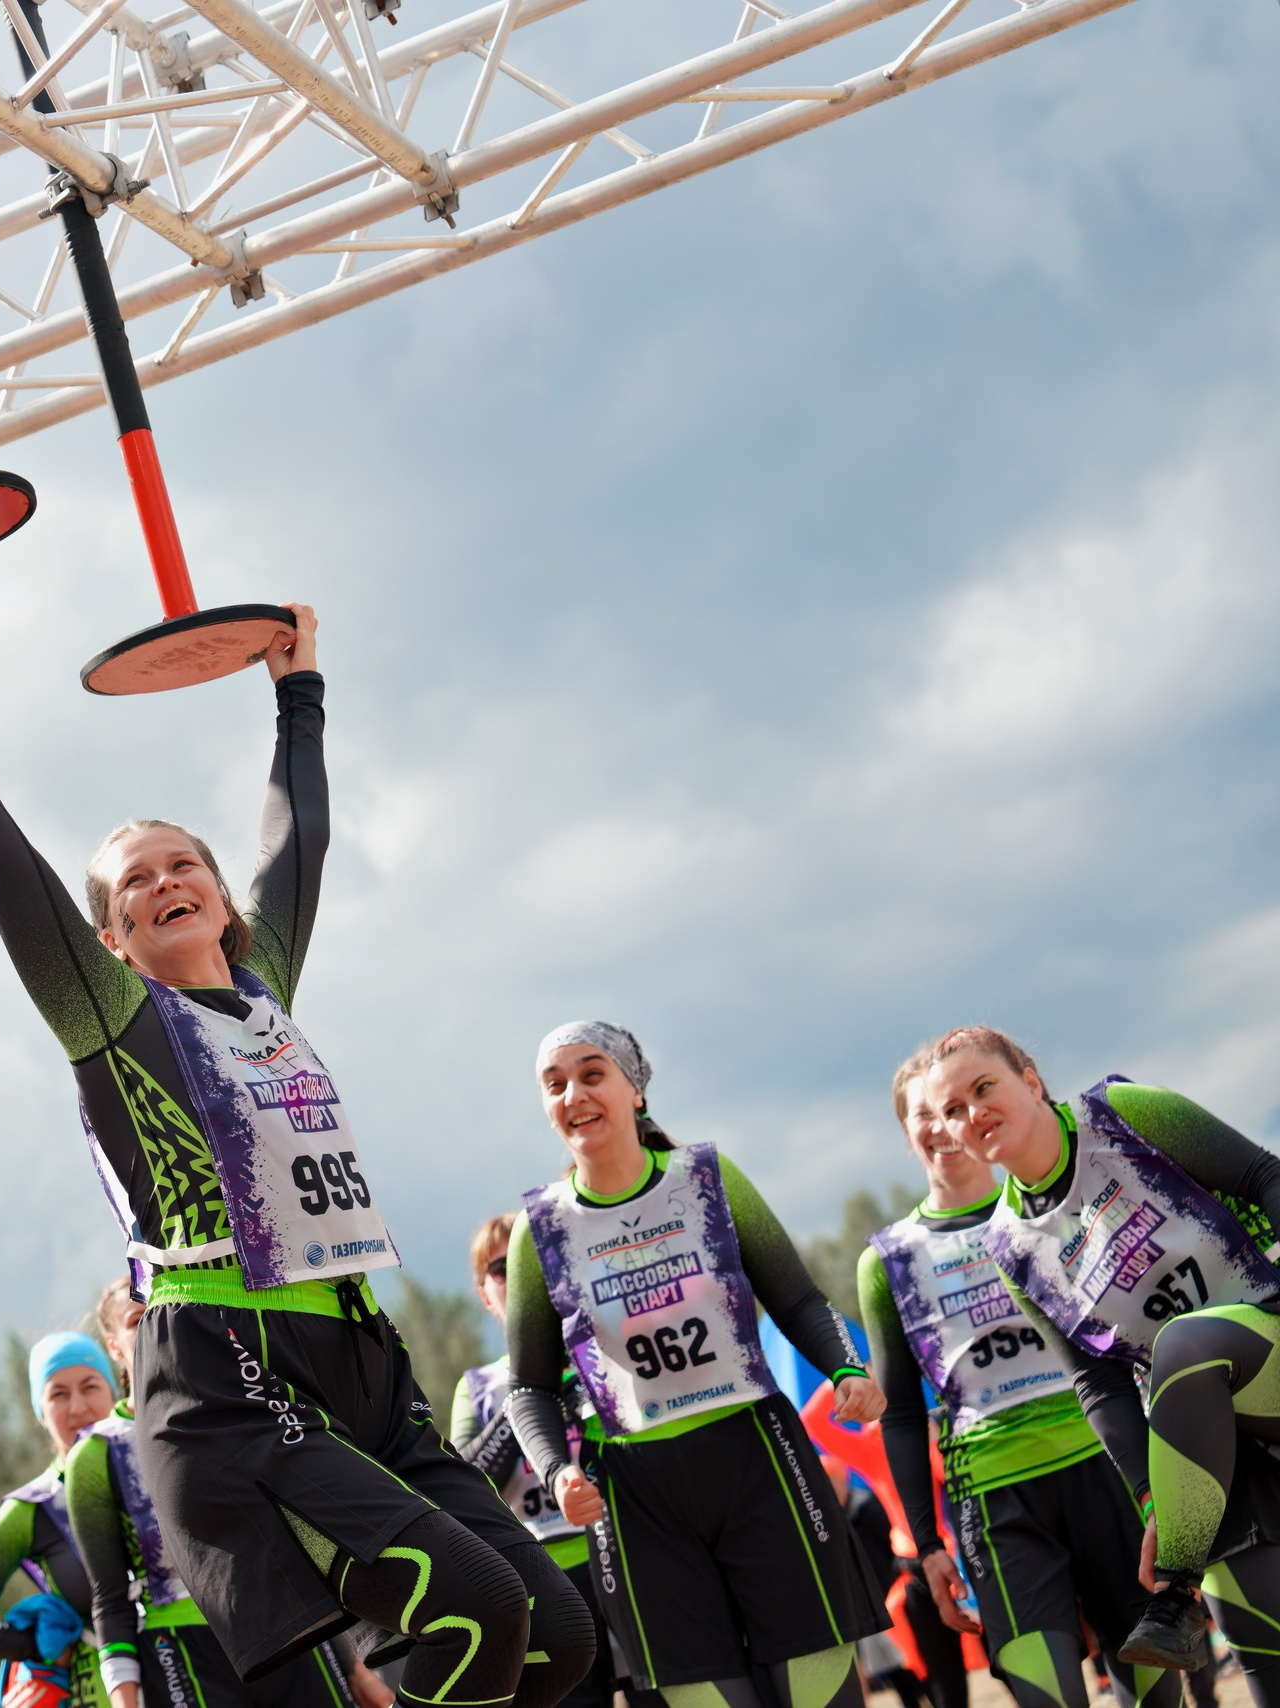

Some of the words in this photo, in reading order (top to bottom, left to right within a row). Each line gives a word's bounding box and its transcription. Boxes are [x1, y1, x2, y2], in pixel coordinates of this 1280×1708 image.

[253, 1073, 336, 1104] МАССОВЫЙ
[289, 1104, 333, 1130] СТАРТ
[291, 1151, 371, 1216] 995
[587, 1235, 630, 1257] ГОНКА
[634, 1219, 685, 1242] ГЕРОЕВ
[1058, 1226, 1090, 1264] ГОНКА
[1086, 1178, 1121, 1224] ГЕРОЕВ
[331, 1239, 387, 1259] ГАЗПРОМБАНК
[933, 1254, 974, 1275] ГОНКА
[1085, 1202, 1161, 1299] МАССОВЫЙ
[1115, 1241, 1160, 1290] СТАРТ
[595, 1252, 699, 1302] МАССОВЫЙ
[626, 1282, 679, 1315] СТАРТ
[1143, 1256, 1209, 1321] 957
[626, 1317, 717, 1380] 962
[666, 1382, 736, 1410] ГАЗПРОМБАНК
[998, 1370, 1065, 1395] ГАЗПРОМБАНК
[960, 1498, 985, 1579] Greenwa
